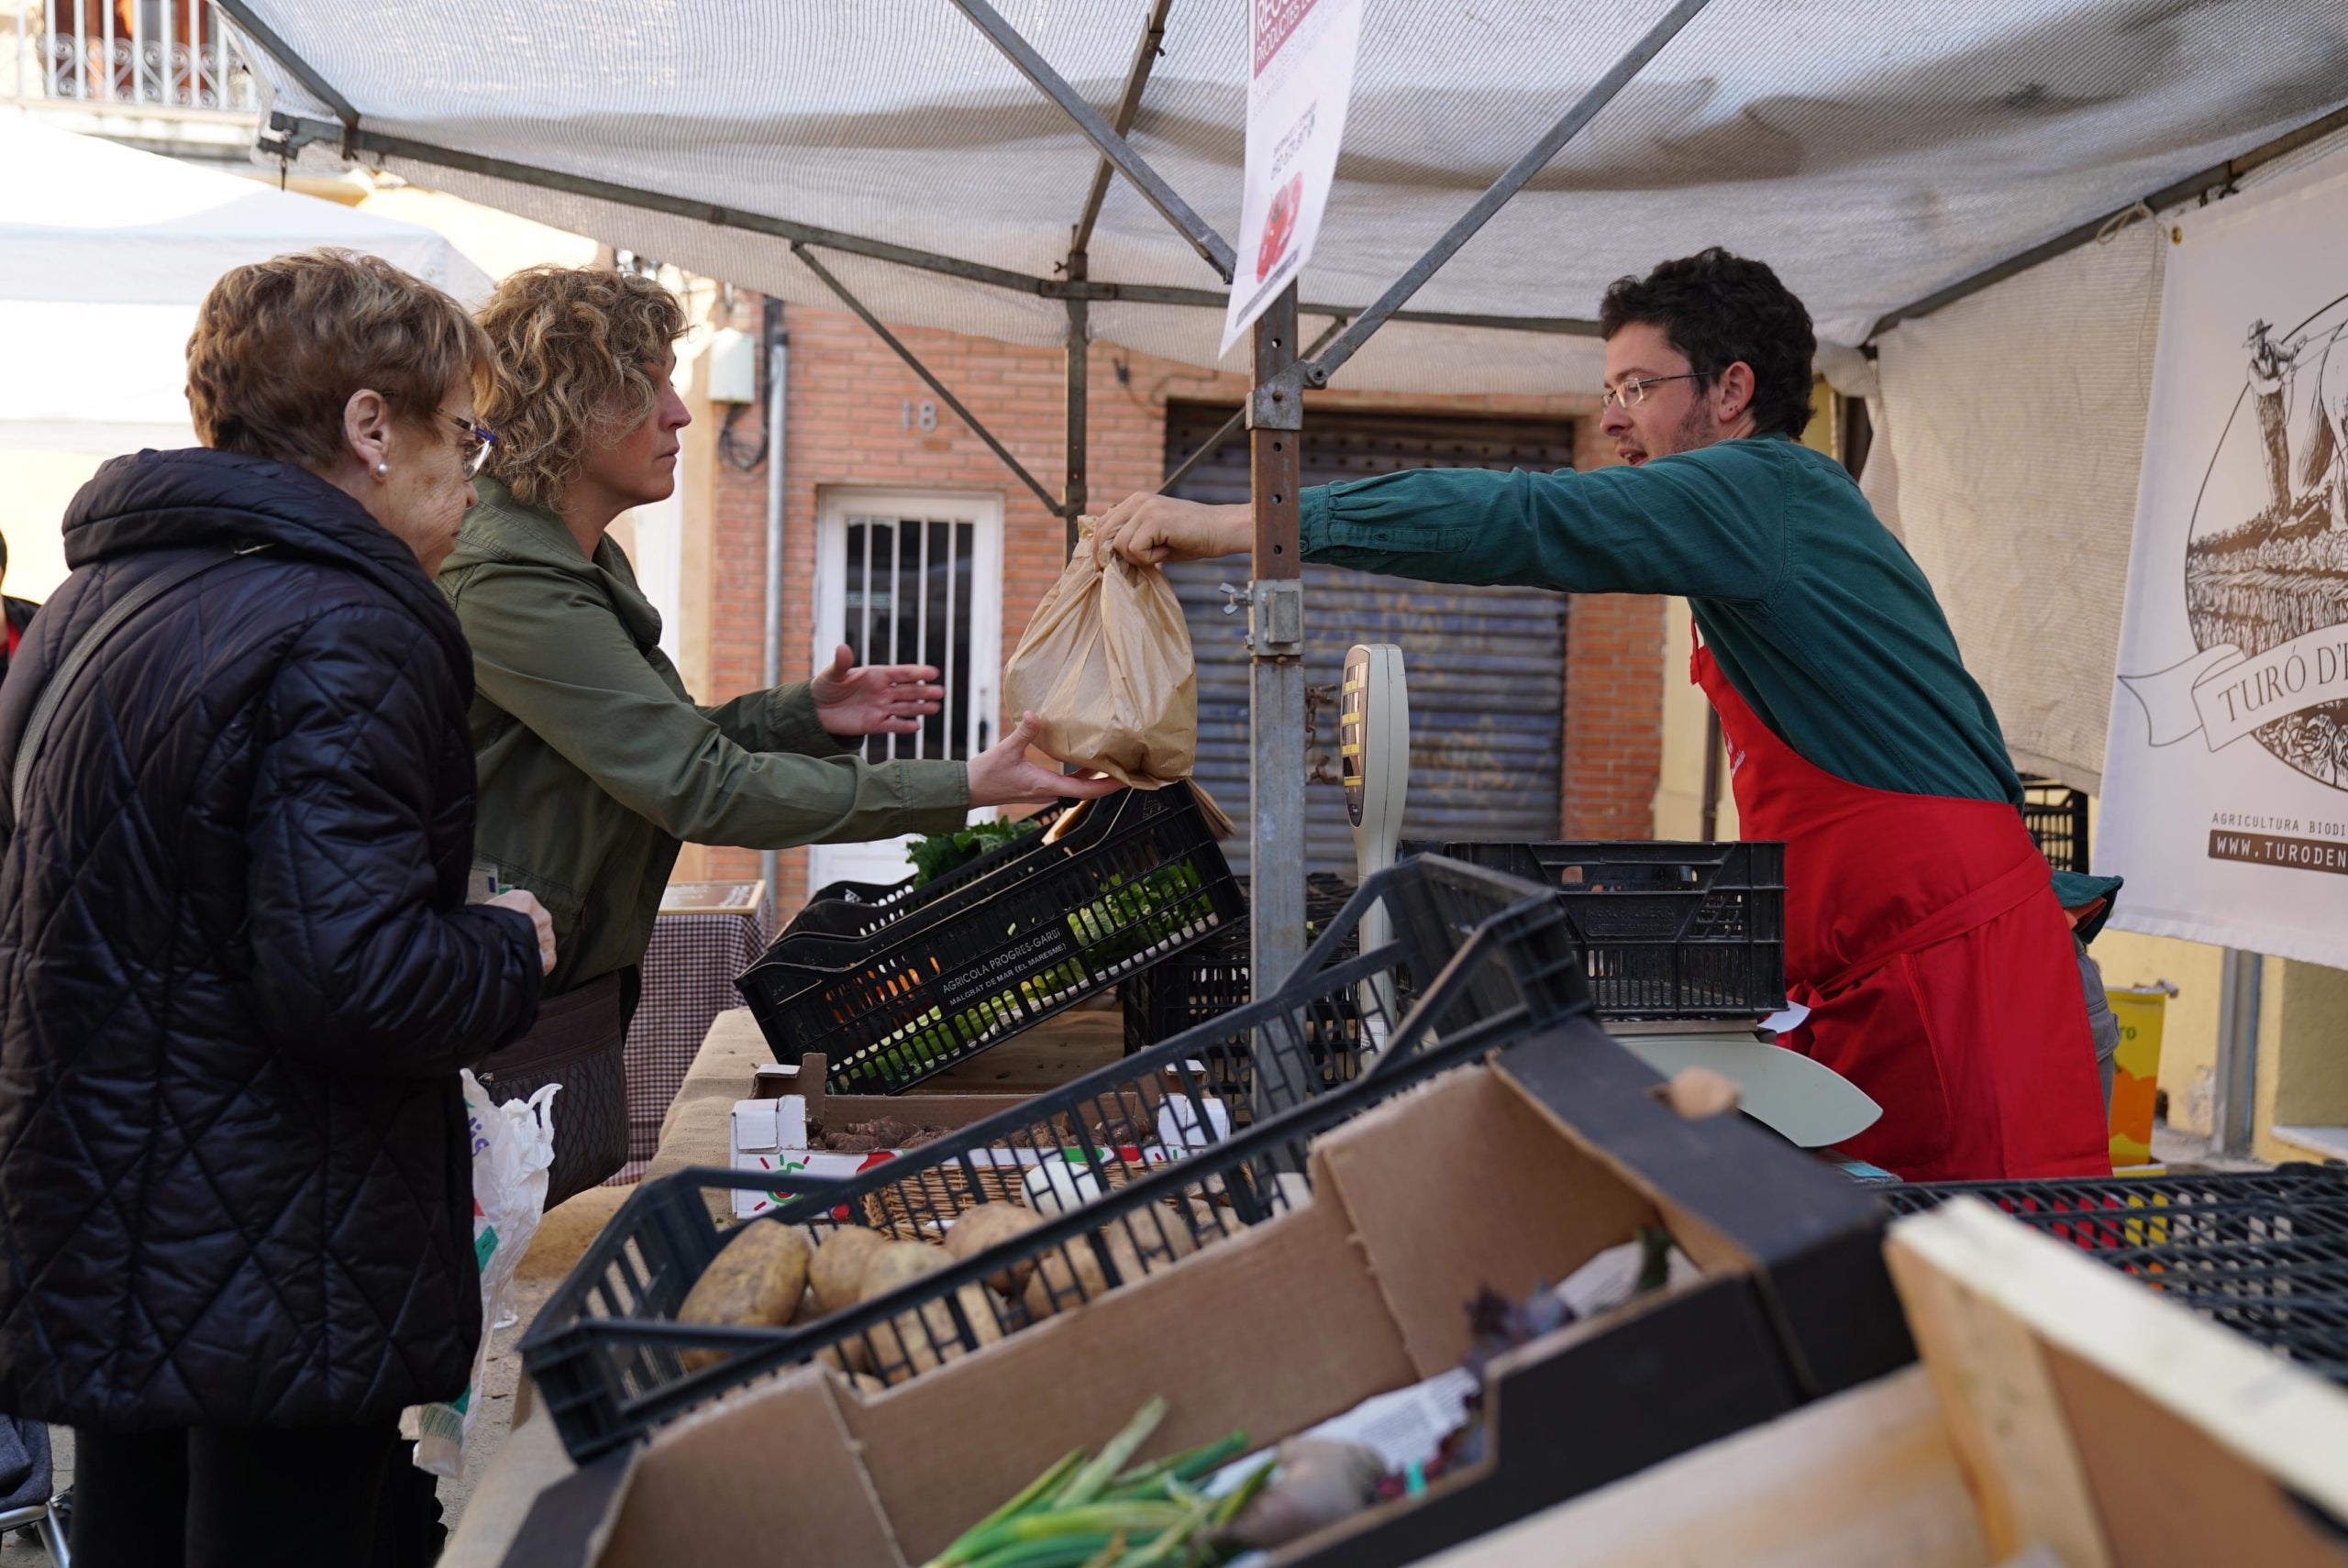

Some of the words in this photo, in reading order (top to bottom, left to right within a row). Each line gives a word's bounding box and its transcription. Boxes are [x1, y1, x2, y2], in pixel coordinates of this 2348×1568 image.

[901, 400, 938, 432] 18
[2218, 645, 2307, 722] TURÓ
[2212, 812, 2299, 832] AGRICULTURA
[2216, 835, 2347, 868] WWW.TURODEN
[949, 984, 984, 1007] MALGRAT
[986, 977, 997, 988] DE
[996, 968, 1014, 983] MAR
[1028, 943, 1068, 966] MARESME)
